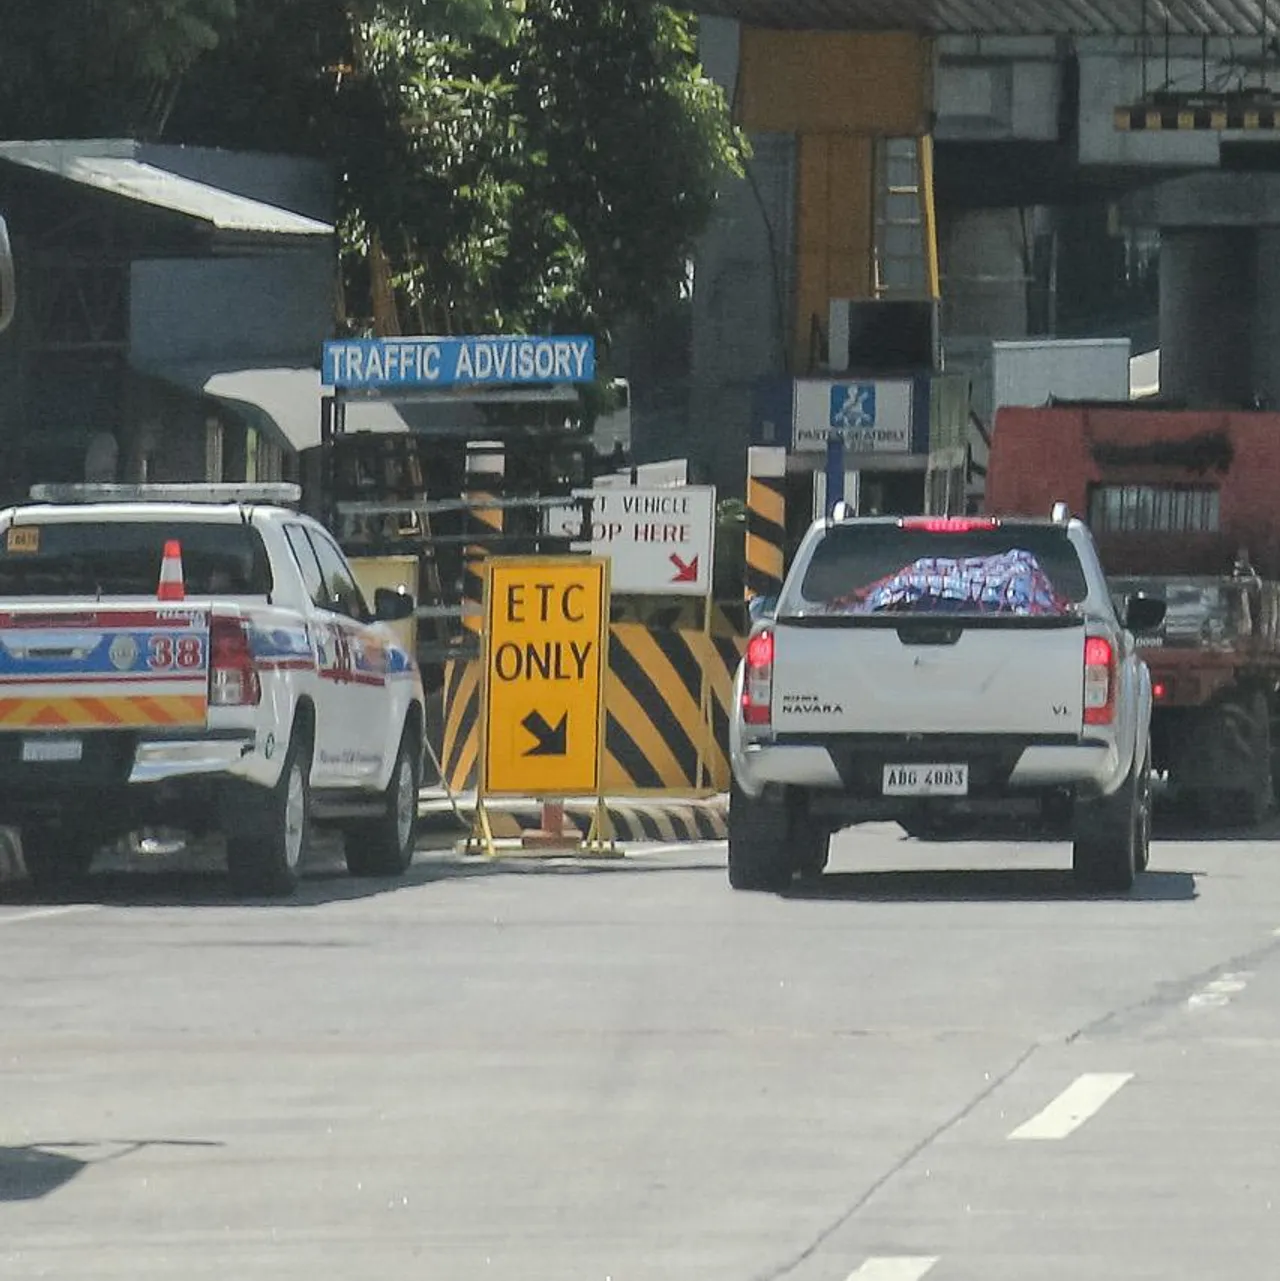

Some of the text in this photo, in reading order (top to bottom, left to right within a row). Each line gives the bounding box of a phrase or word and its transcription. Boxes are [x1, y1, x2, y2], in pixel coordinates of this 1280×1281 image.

[328, 340, 589, 382] TRAFFIC ADVISORY
[623, 496, 693, 514] VEHICLE
[634, 522, 693, 543] HERE
[506, 583, 585, 622] ETC
[146, 634, 203, 670] 38
[494, 640, 593, 681] ONLY
[782, 704, 844, 714] NAVARA
